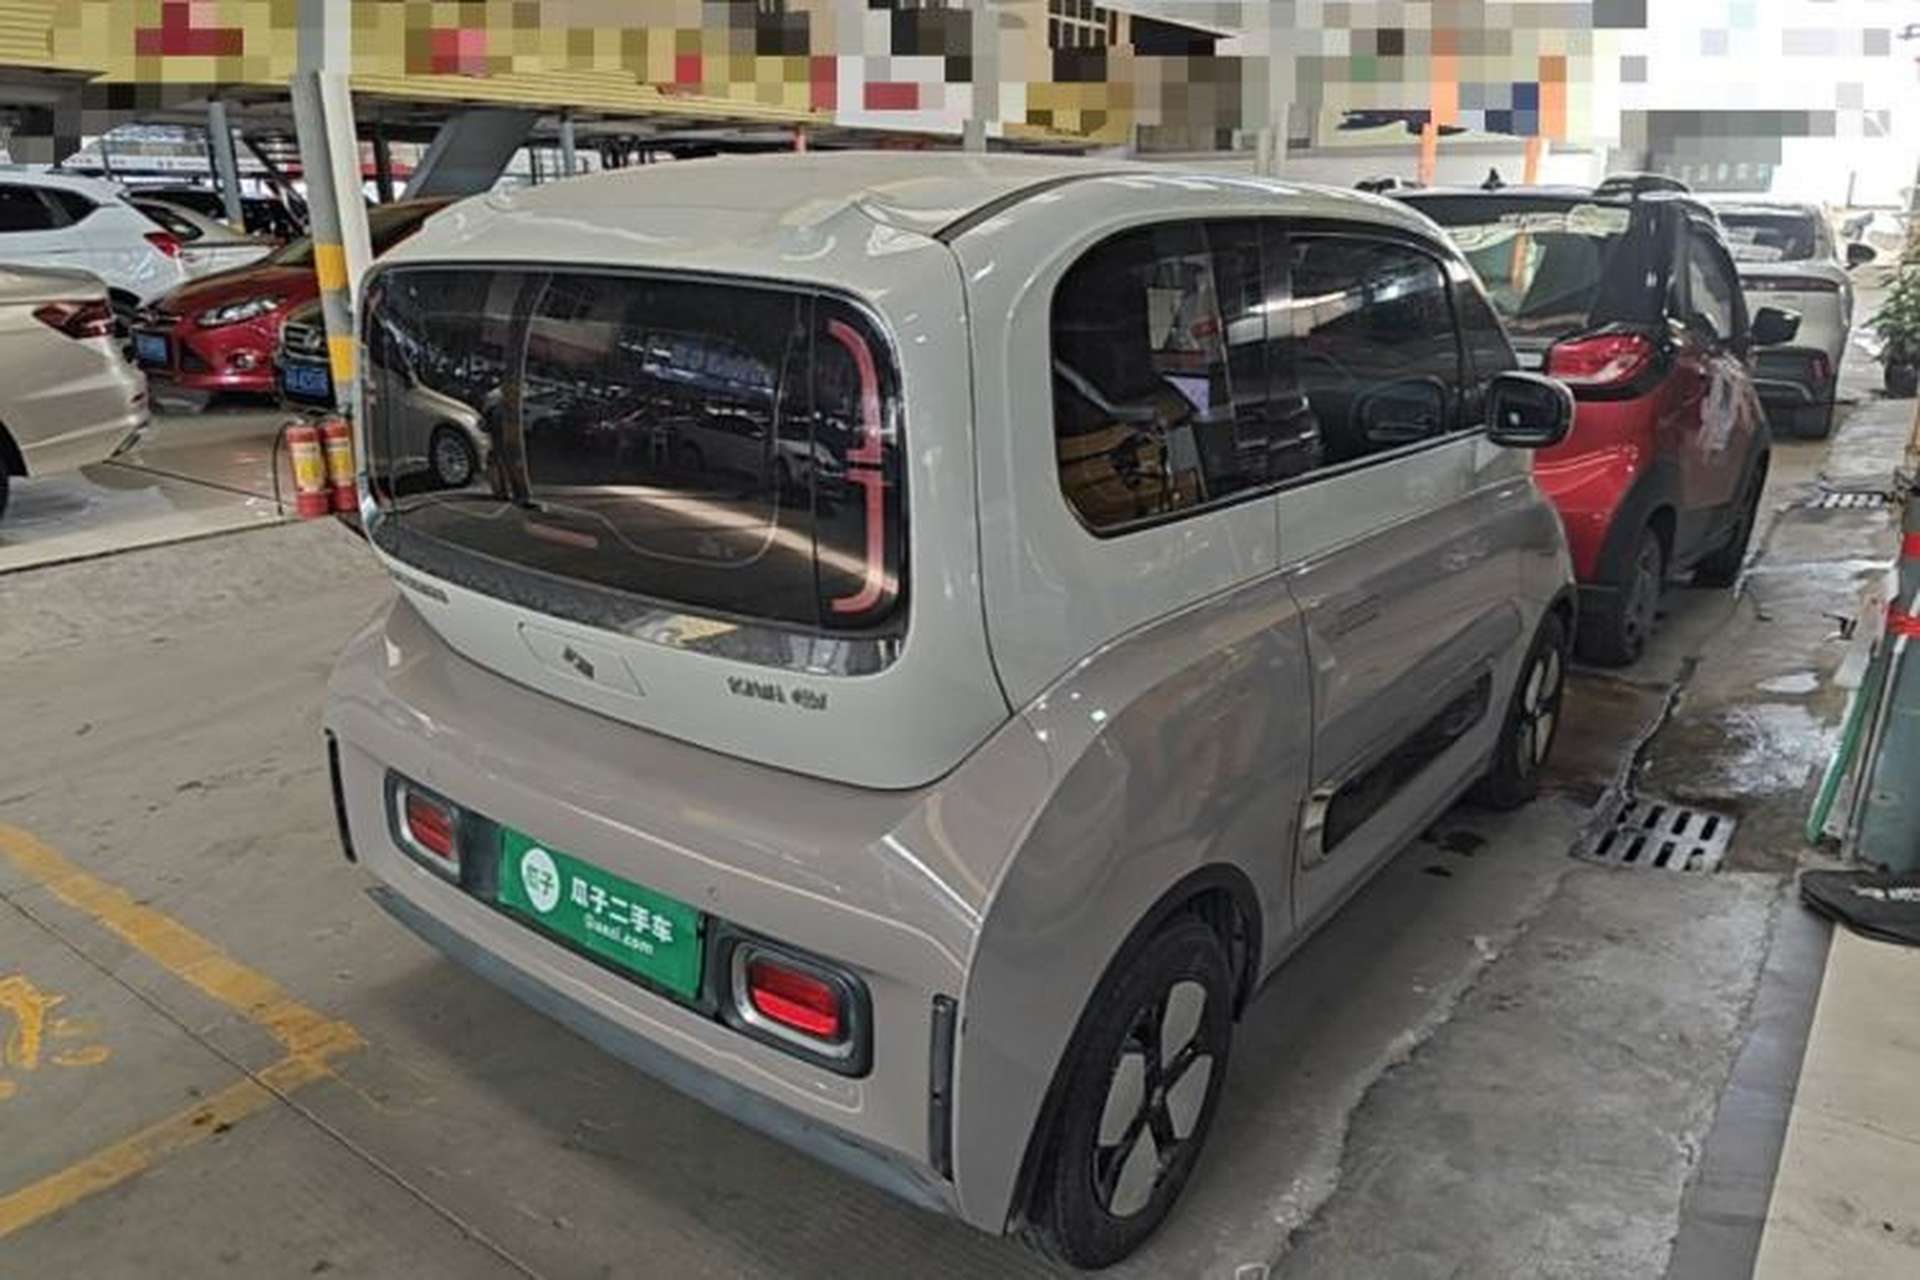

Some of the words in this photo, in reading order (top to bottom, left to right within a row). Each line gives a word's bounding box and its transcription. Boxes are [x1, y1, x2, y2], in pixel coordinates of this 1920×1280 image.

[571, 876, 674, 943] 瓜子二手车
